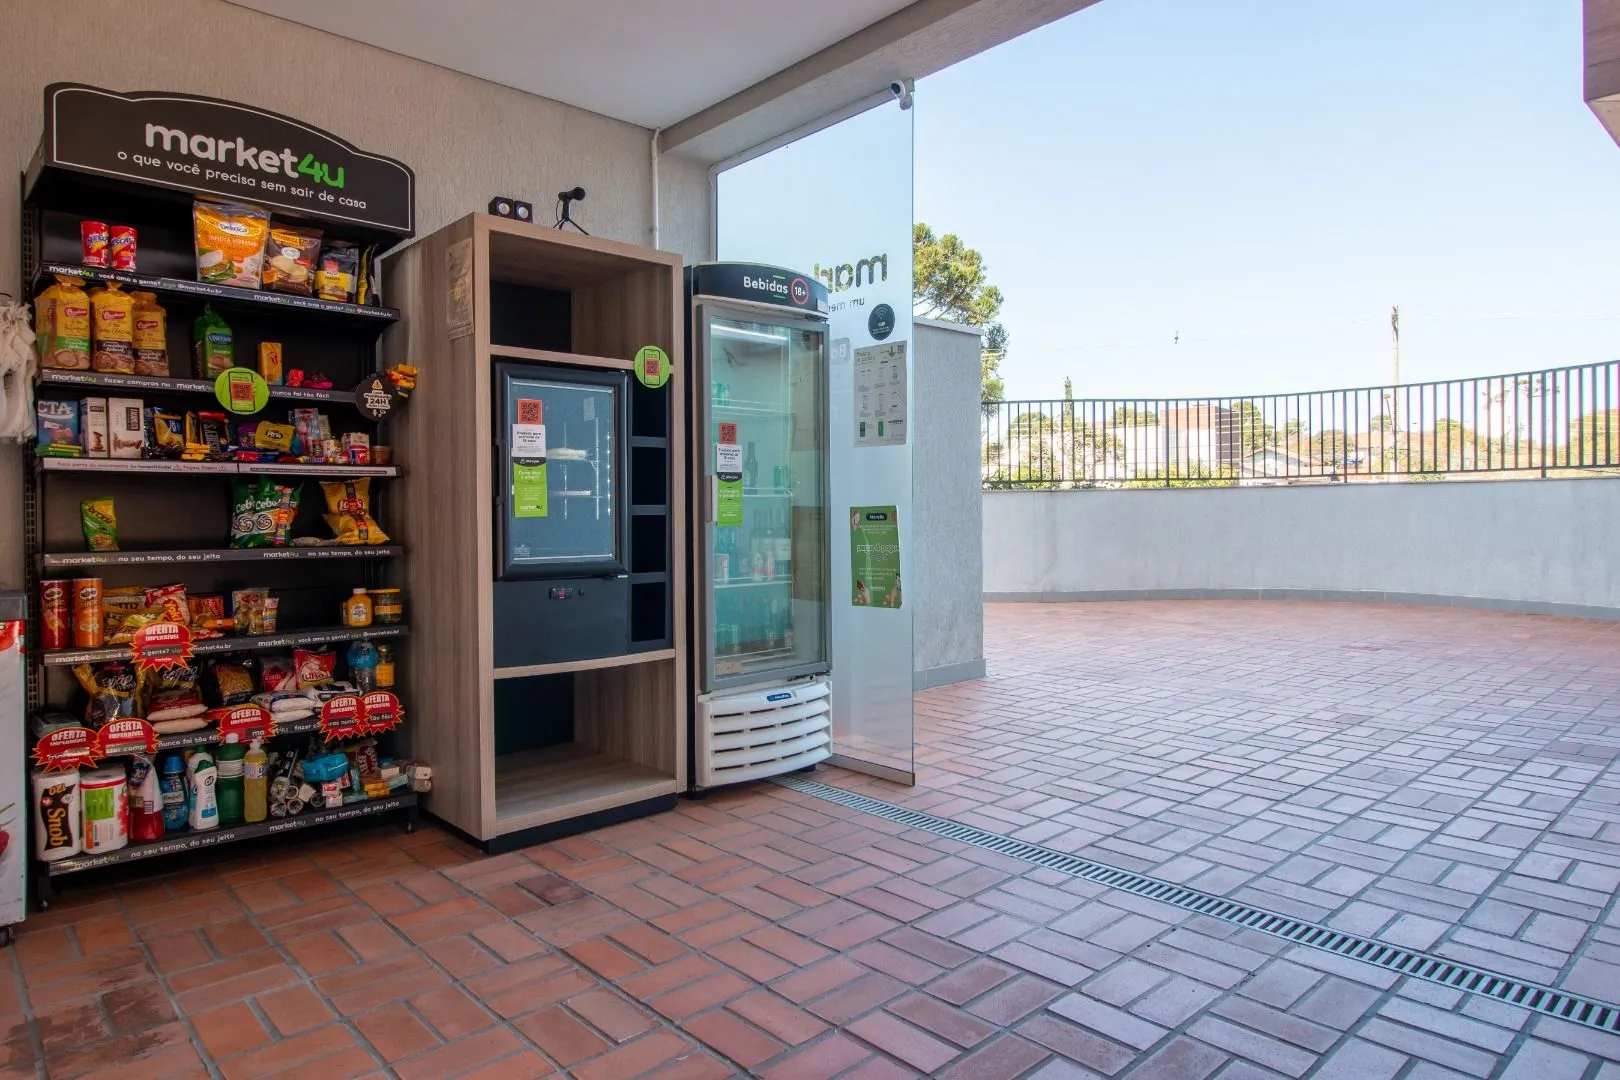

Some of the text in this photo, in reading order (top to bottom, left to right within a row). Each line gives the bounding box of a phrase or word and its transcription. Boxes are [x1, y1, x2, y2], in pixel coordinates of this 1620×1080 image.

[145, 123, 345, 189] market4u
[117, 151, 367, 209] o que você precisa sem sair de casa
[49, 265, 94, 278] market4u
[743, 276, 807, 297] Bebidas 18+
[145, 624, 179, 635] OFERTA
[330, 698, 357, 707] OFERTA
[231, 709, 261, 719] OFERTA
[109, 721, 143, 733] OFERTA
[51, 730, 87, 742] OFERTA
[46, 807, 67, 847] Snob
[143, 848, 158, 856] seu
[190, 838, 200, 846] do
[201, 837, 215, 845] seu
